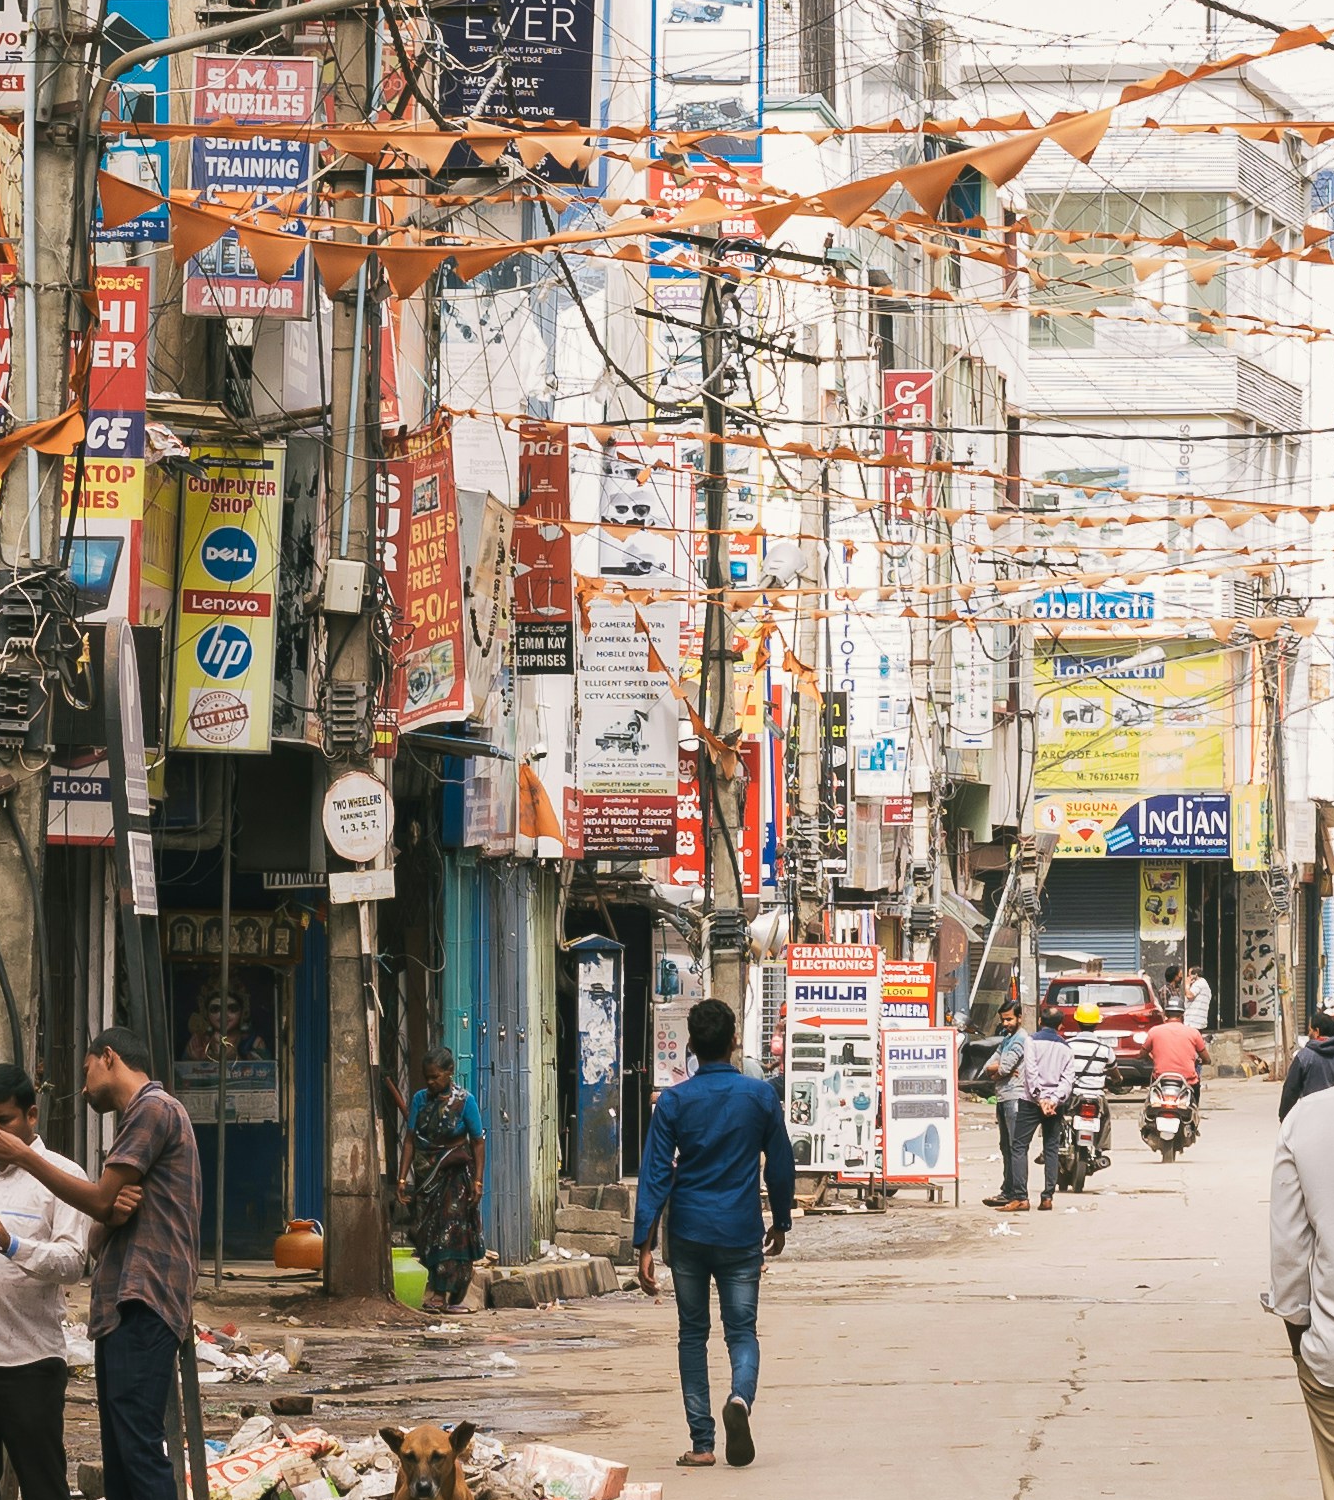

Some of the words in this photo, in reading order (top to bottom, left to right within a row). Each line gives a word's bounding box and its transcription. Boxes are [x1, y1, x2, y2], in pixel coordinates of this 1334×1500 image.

[208, 68, 305, 91] S.M.D.
[206, 93, 304, 116] MOBILES
[205, 157, 299, 180] TRAINING
[241, 288, 293, 308] FLOOR
[188, 477, 276, 496] COMPUTER
[210, 498, 253, 514] SHOP
[206, 547, 252, 562] DELL
[192, 595, 259, 612] Lenovo
[428, 620, 460, 641] ONLY
[193, 714, 216, 728] BEST
[218, 708, 246, 723] PRICE
[333, 800, 347, 811] TWO
[348, 794, 381, 808] WHEELERS
[1067, 804, 1117, 812] SUGUNA
[640, 818, 672, 826] CENTER
[793, 947, 872, 959] CHAMUNDA
[792, 960, 874, 970] ELECTRONICS
[796, 986, 867, 1000] AHUJA
[889, 1048, 946, 1060] AHUJA
